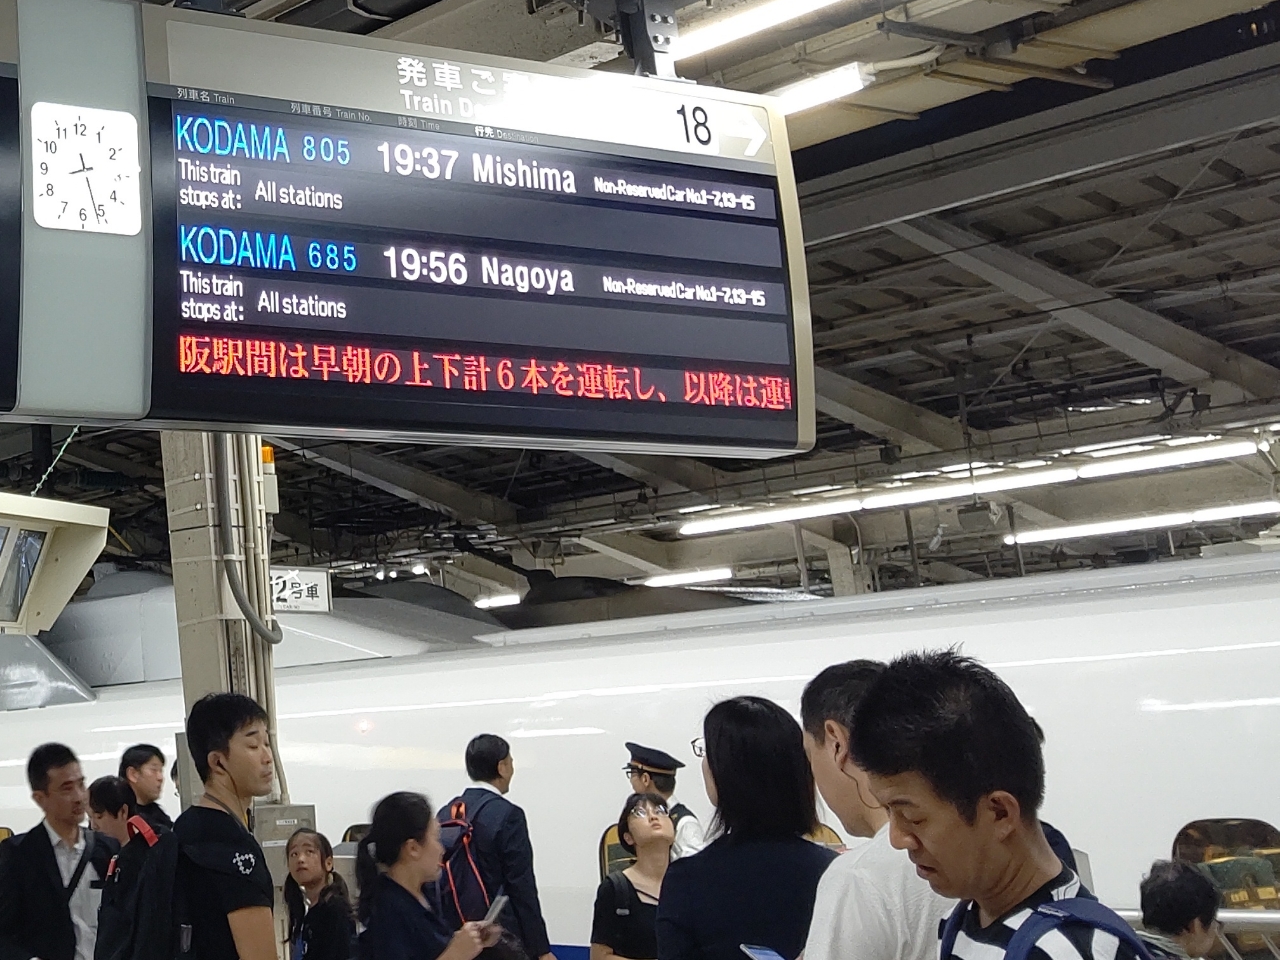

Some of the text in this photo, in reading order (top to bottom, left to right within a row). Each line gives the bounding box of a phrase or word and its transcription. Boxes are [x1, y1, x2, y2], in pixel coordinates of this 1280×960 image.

[177, 87, 235, 105] 列車名 Train
[400, 89, 453, 115] Train
[290, 102, 372, 122] 列車番号 Train No.
[73, 123, 87, 136] 12
[398, 116, 440, 130] 時刻 Time
[475, 125, 494, 137] 行先
[677, 104, 712, 145] 18
[56, 127, 67, 139] 11
[96, 131, 101, 143] 1
[44, 140, 57, 154] 10
[108, 148, 116, 160] 2
[176, 115, 290, 164] KODAMA
[302, 135, 351, 165] 805
[377, 141, 459, 180] 19:37
[472, 153, 577, 193] Mishima
[40, 162, 48, 175] 9
[178, 158, 241, 186] This train
[46, 183, 54, 196] 8
[109, 190, 117, 202] 4
[180, 185, 242, 210] stops at:
[255, 180, 343, 210] All stations
[61, 201, 68, 213] 7
[79, 208, 87, 221] 6
[97, 204, 105, 217] 5
[180, 224, 297, 271] KODAMA
[308, 242, 357, 272] 685
[383, 246, 468, 285] 19:56
[481, 256, 575, 295] Nagoya
[180, 270, 243, 298] This train
[181, 298, 245, 322] stops at:
[257, 290, 347, 319] All stations
[270, 575, 319, 602] 2号車
